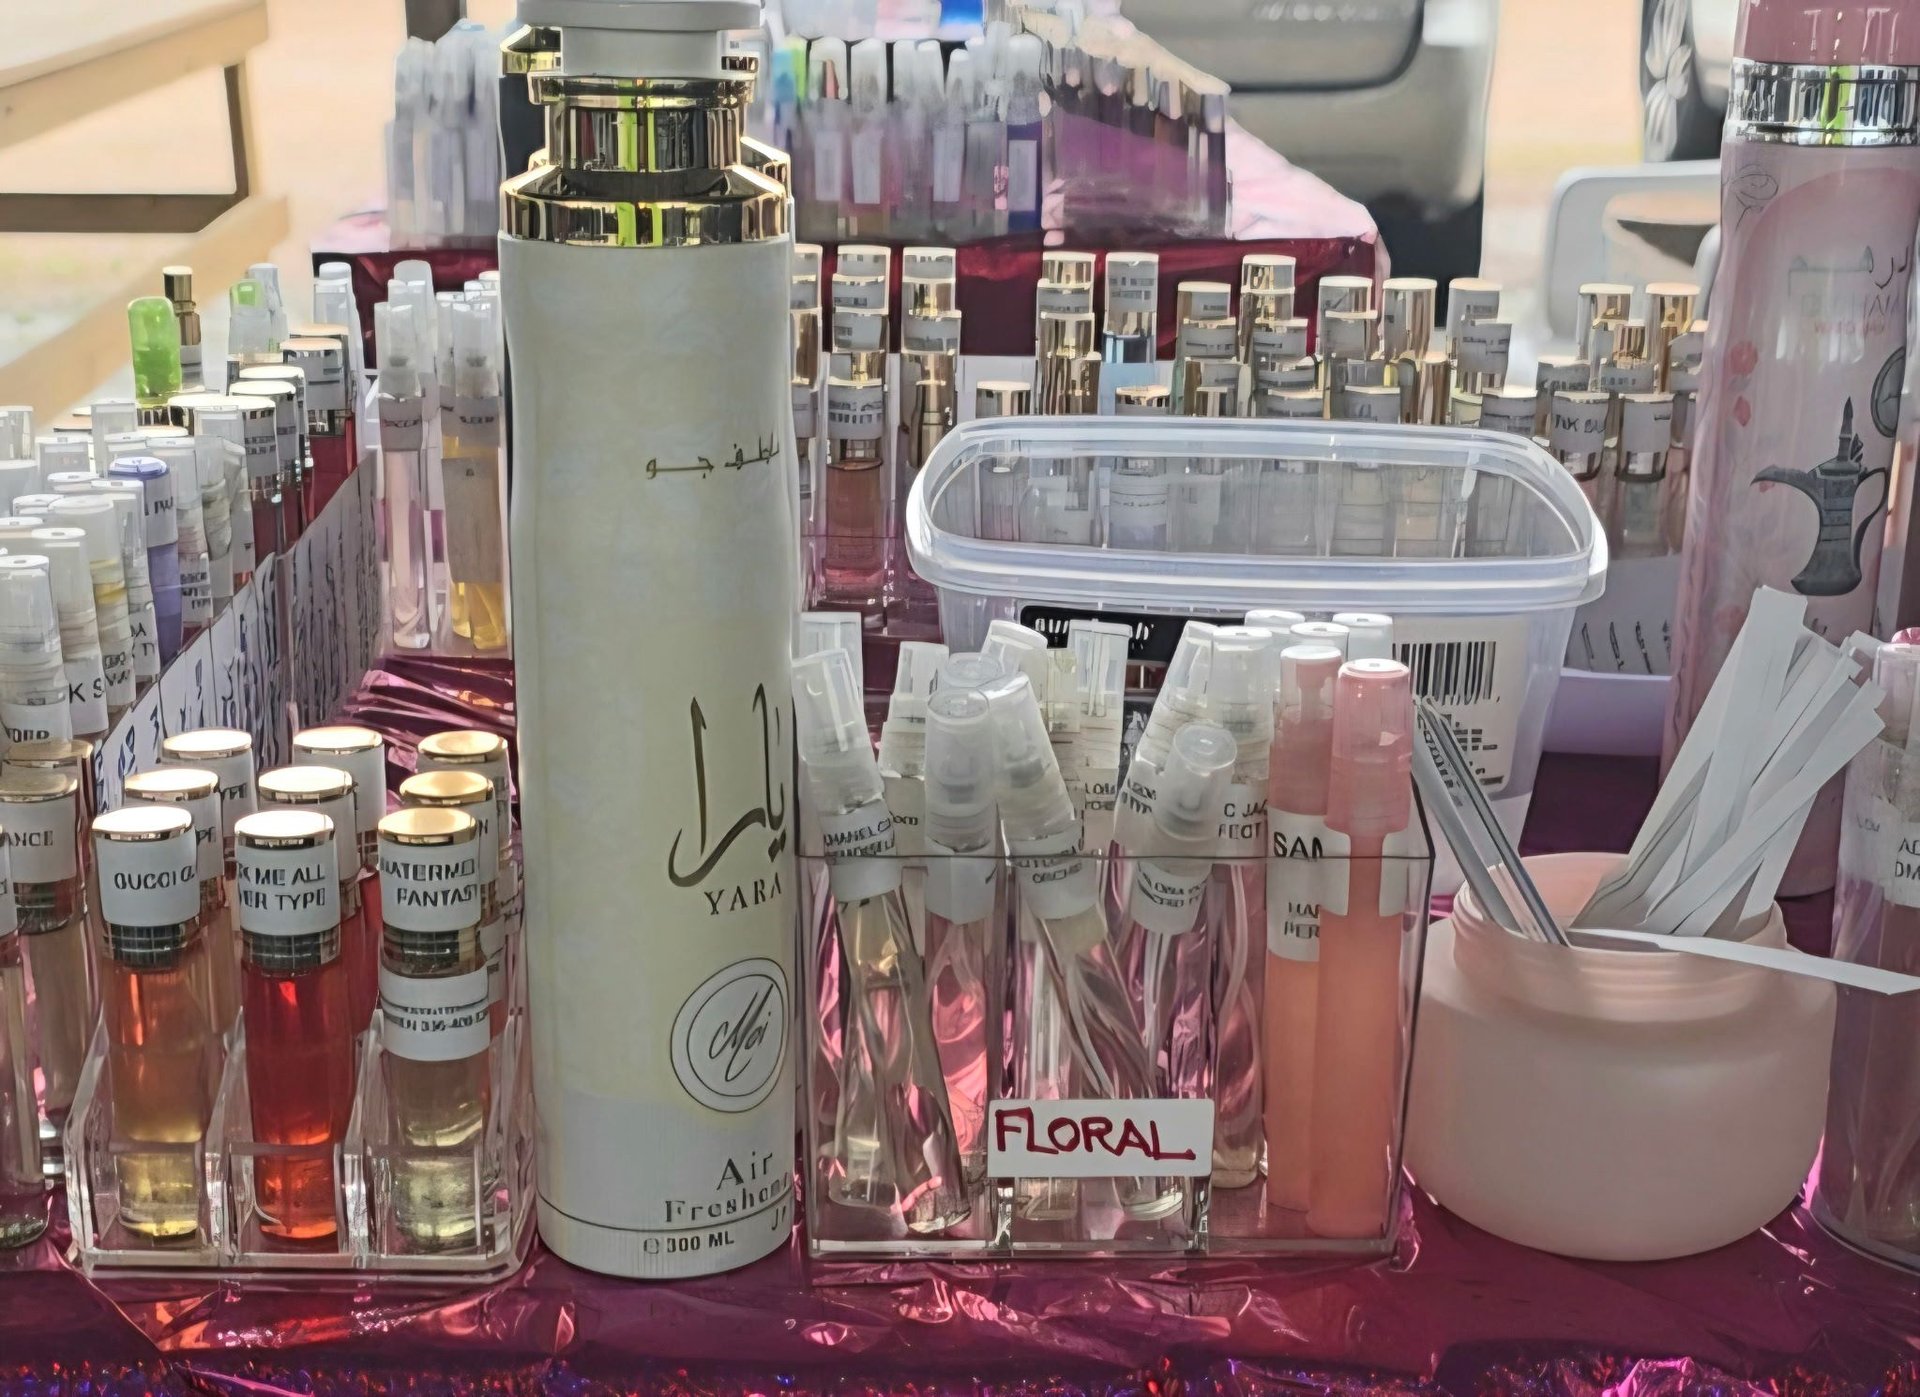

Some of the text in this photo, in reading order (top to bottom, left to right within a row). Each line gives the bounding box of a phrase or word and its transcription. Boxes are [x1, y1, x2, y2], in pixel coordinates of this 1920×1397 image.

[704, 871, 783, 915] YARA
[995, 1106, 1196, 1160] FLORAL
[716, 1151, 773, 1190] Air
[708, 1230, 735, 1248] ML
